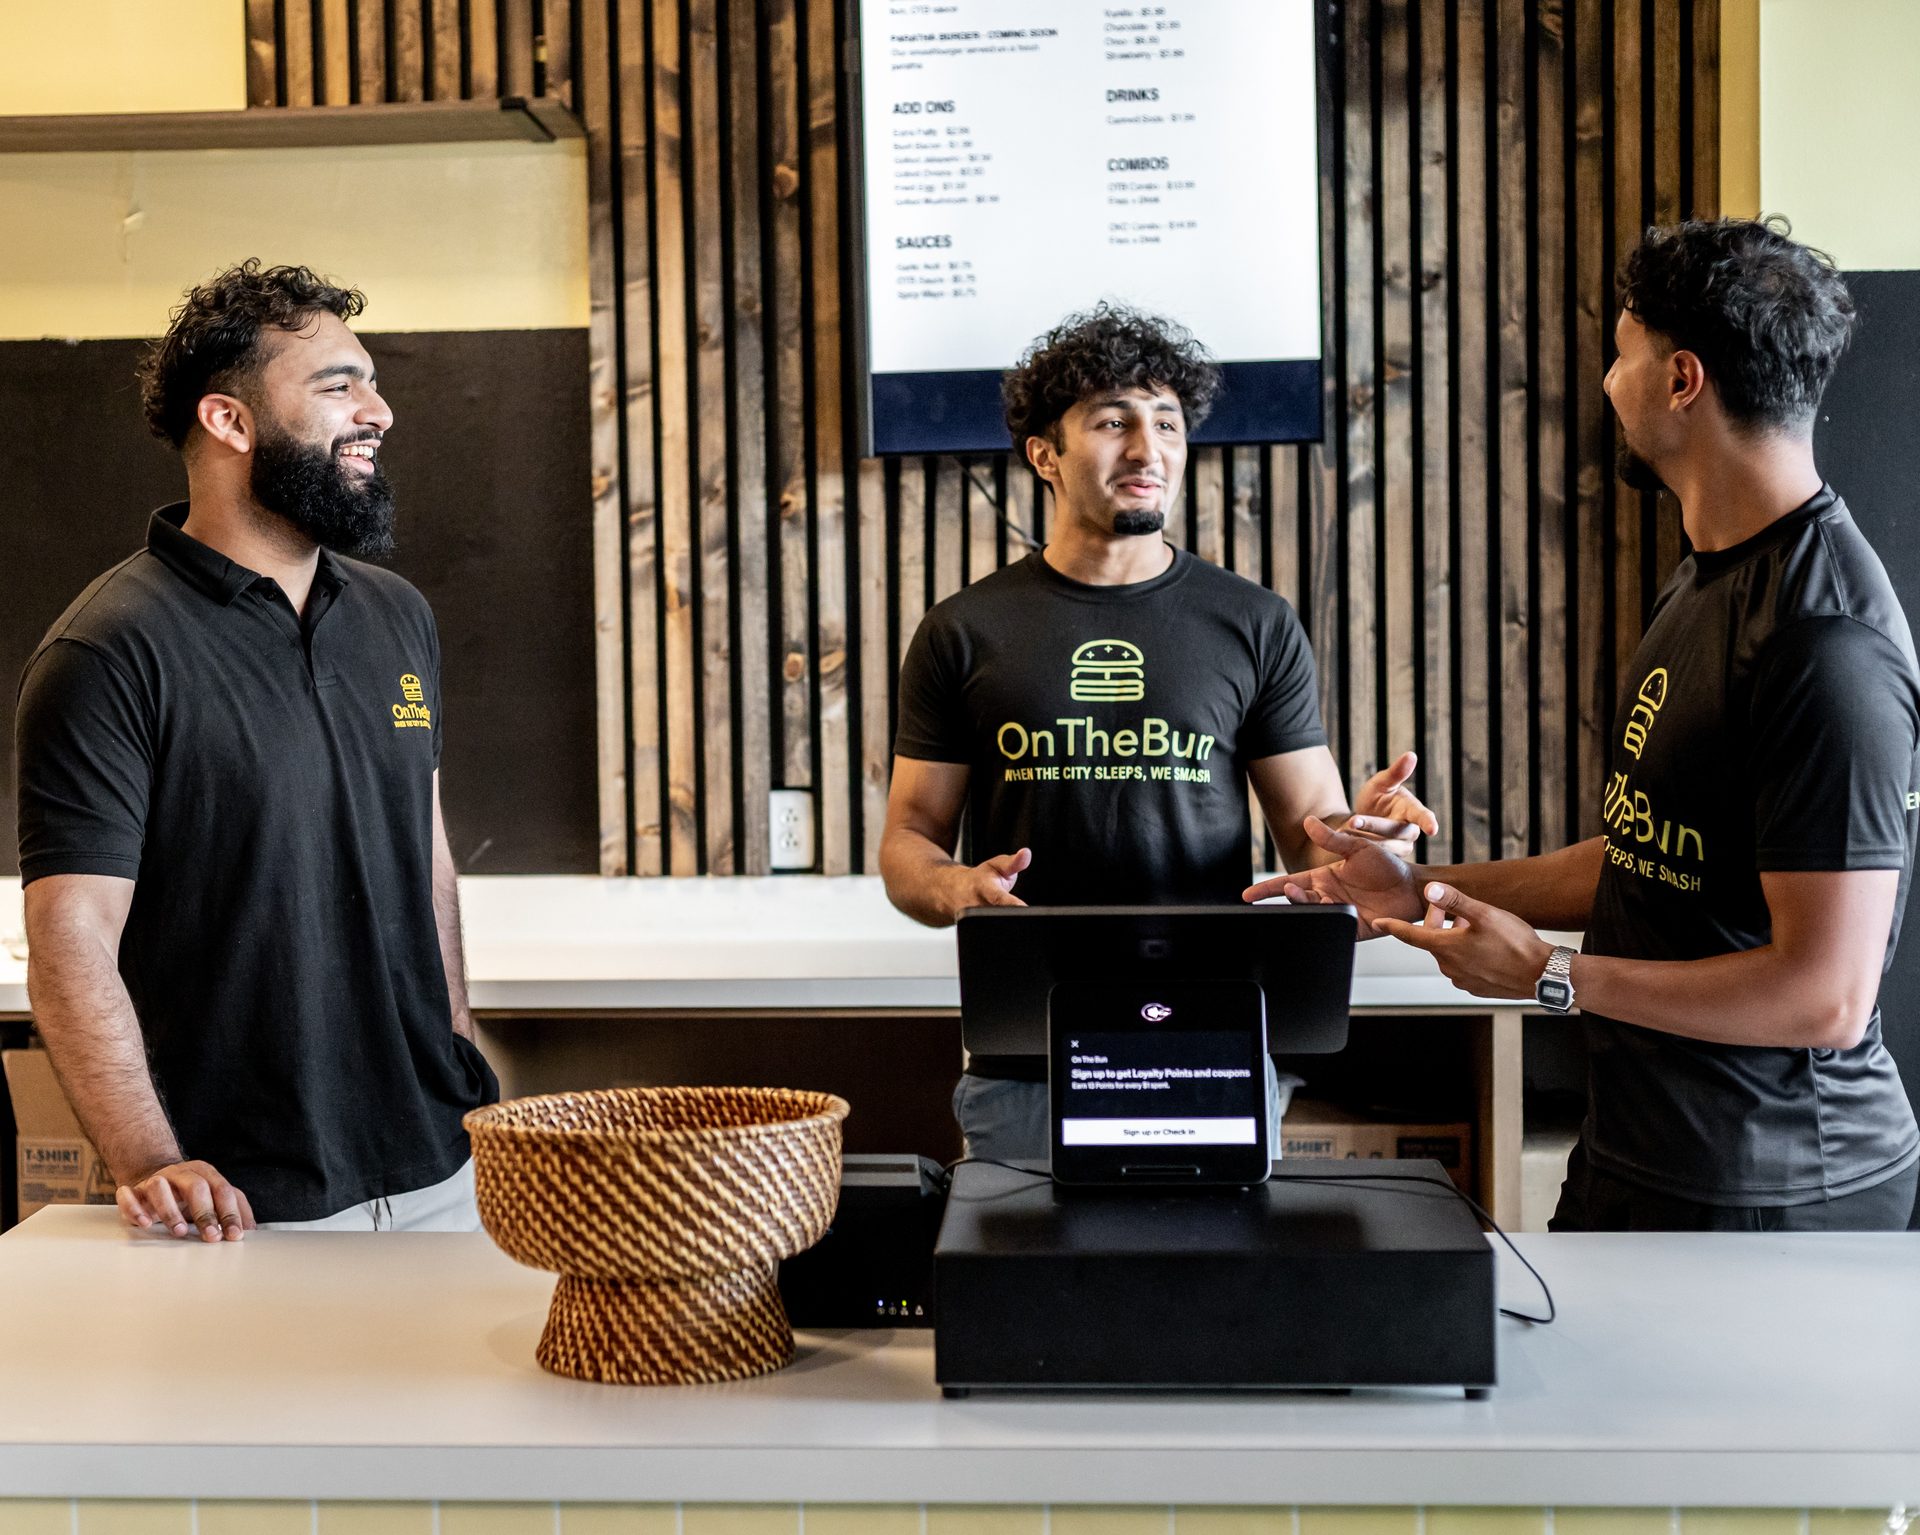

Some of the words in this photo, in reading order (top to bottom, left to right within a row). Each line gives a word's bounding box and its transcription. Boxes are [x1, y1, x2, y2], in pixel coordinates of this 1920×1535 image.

[1105, 87, 1160, 104] DRINKS
[892, 101, 922, 115] ADD
[925, 99, 956, 114] ONS
[1106, 156, 1170, 173] COMBOS
[895, 234, 952, 250] SAUCES
[997, 716, 1215, 760] OnTheBun
[1035, 766, 1060, 780] THE
[1063, 766, 1092, 780] CITY
[1094, 766, 1147, 782] SLEEPS,
[1150, 766, 1172, 780] WE
[1173, 766, 1211, 783] SMASH
[1638, 858, 1655, 878] WE
[1071, 1068, 1092, 1080] Sign
[1093, 1070, 1106, 1080] up
[1105, 1069, 1116, 1079] to
[1116, 1069, 1132, 1080] get
[1132, 1068, 1164, 1080] Loyalty
[1164, 1068, 1193, 1078] Points
[1194, 1068, 1212, 1078] and
[1212, 1069, 1251, 1079] coupons
[1123, 1129, 1140, 1137] Sign
[1162, 1128, 1186, 1136] Check
[1286, 1139, 1332, 1153] SHIRT
[25, 1149, 79, 1161] T-SHIRT
